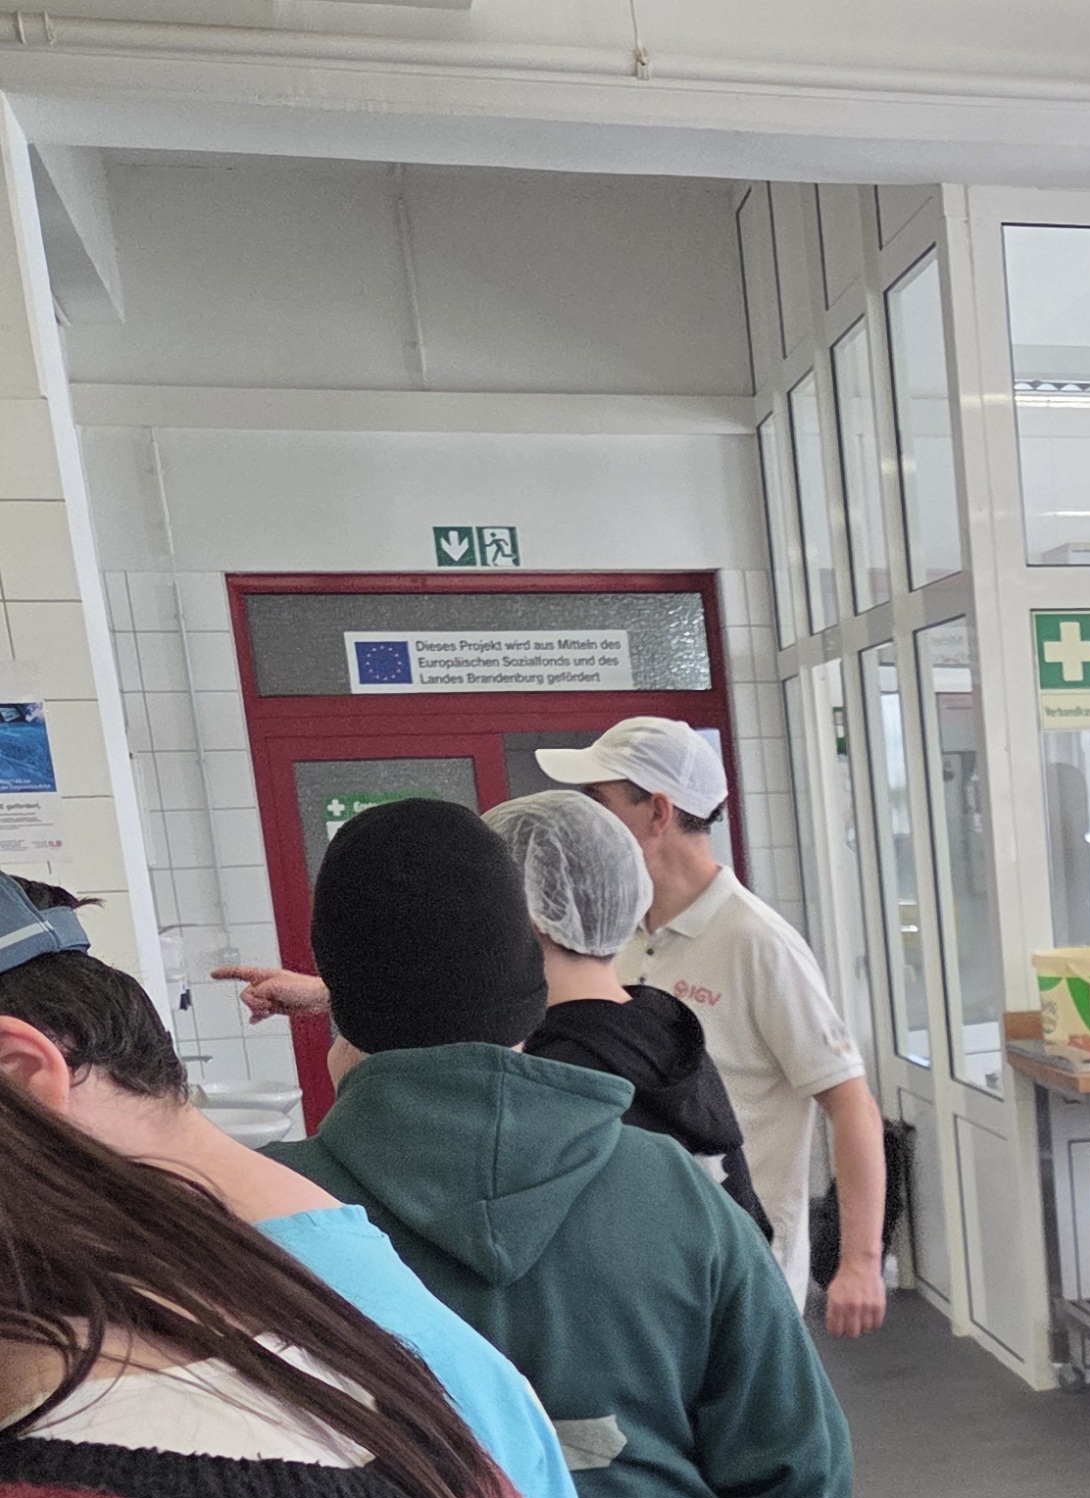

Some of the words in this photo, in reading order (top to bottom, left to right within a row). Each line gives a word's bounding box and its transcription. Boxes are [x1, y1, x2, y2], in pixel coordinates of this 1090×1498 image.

[415, 640, 457, 652] Dieses
[460, 640, 502, 653] Projekt
[505, 640, 530, 651] wird
[533, 641, 555, 651] aus
[558, 639, 598, 650] Mitteln
[600, 639, 621, 650] des
[418, 656, 499, 669] Europäischen
[502, 655, 571, 667] Sozialfonds
[573, 655, 596, 666] und
[598, 654, 619, 666] des
[420, 672, 464, 685] Landes
[466, 672, 544, 685] Brandenburg
